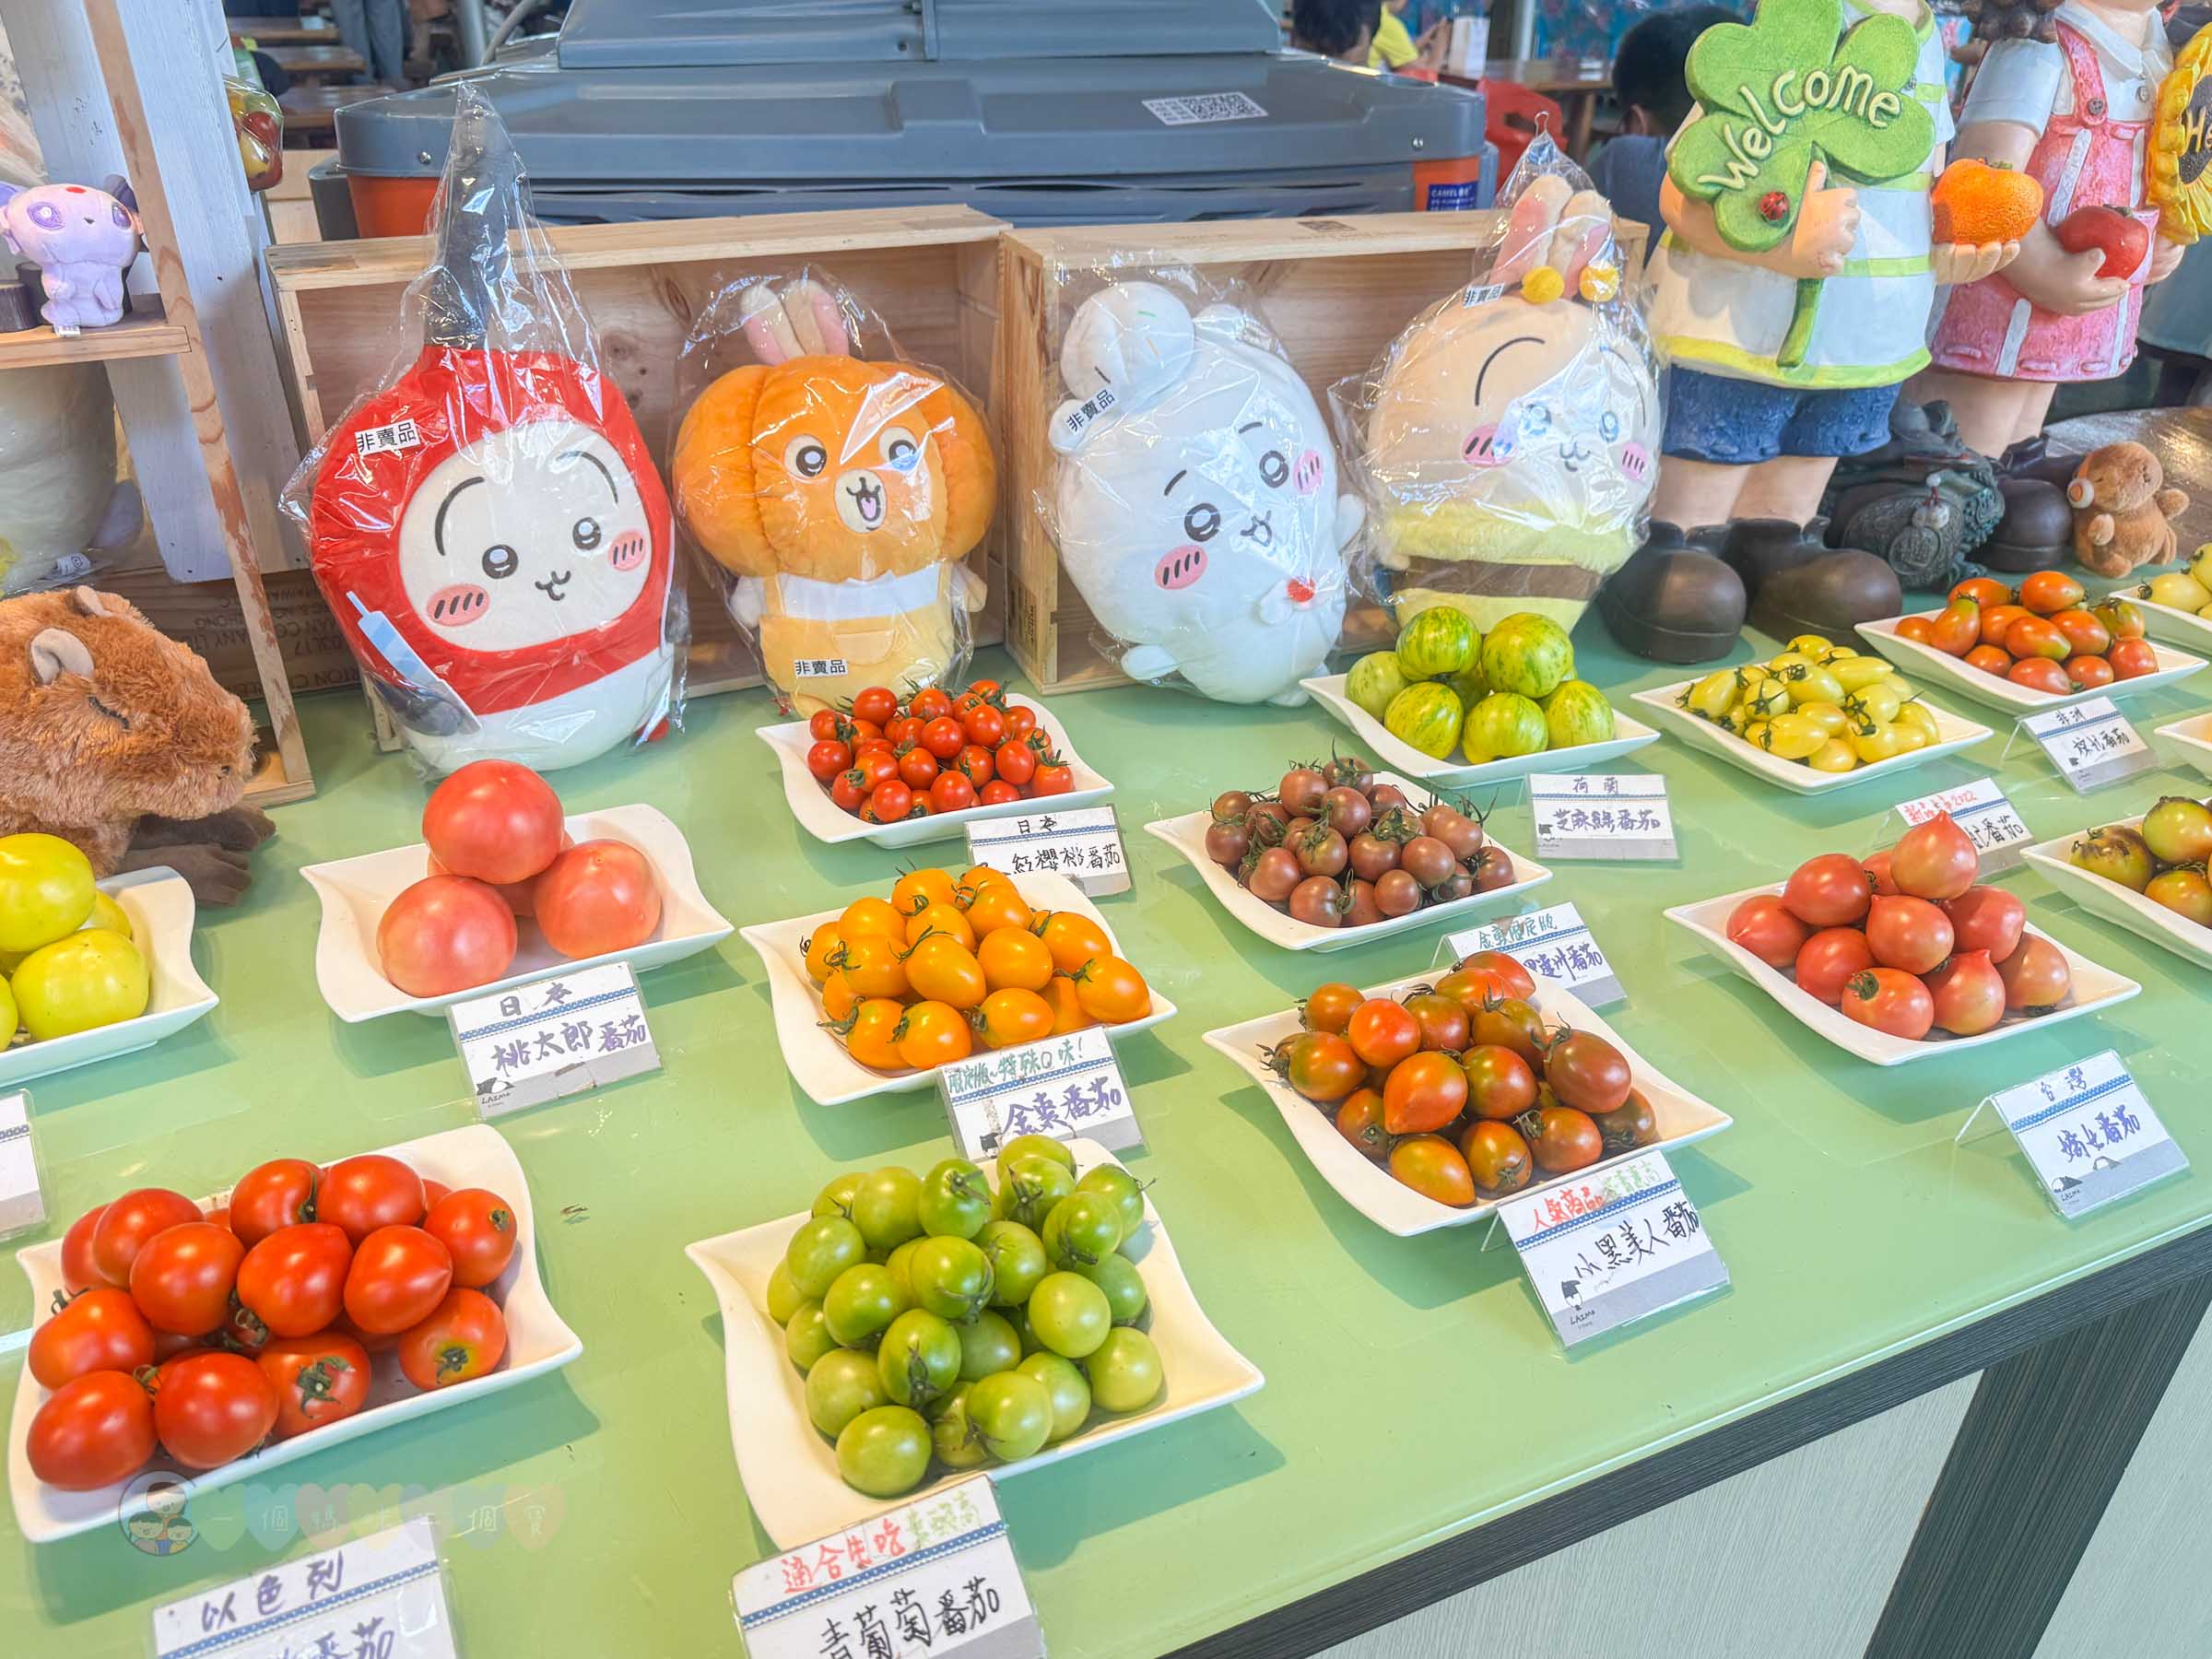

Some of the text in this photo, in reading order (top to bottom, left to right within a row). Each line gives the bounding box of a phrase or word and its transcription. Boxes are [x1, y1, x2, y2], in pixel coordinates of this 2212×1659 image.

[1697, 65, 1901, 190] Welcome
[1066, 389, 1115, 431] 非賣品
[357, 422, 416, 453] 非賣品
[795, 659, 846, 675] 非賣品
[1018, 816, 1057, 834] 日本
[500, 982, 572, 1016] 日本
[491, 1015, 646, 1077] 桃太郎番茄
[201, 1550, 345, 1631] 以色列
